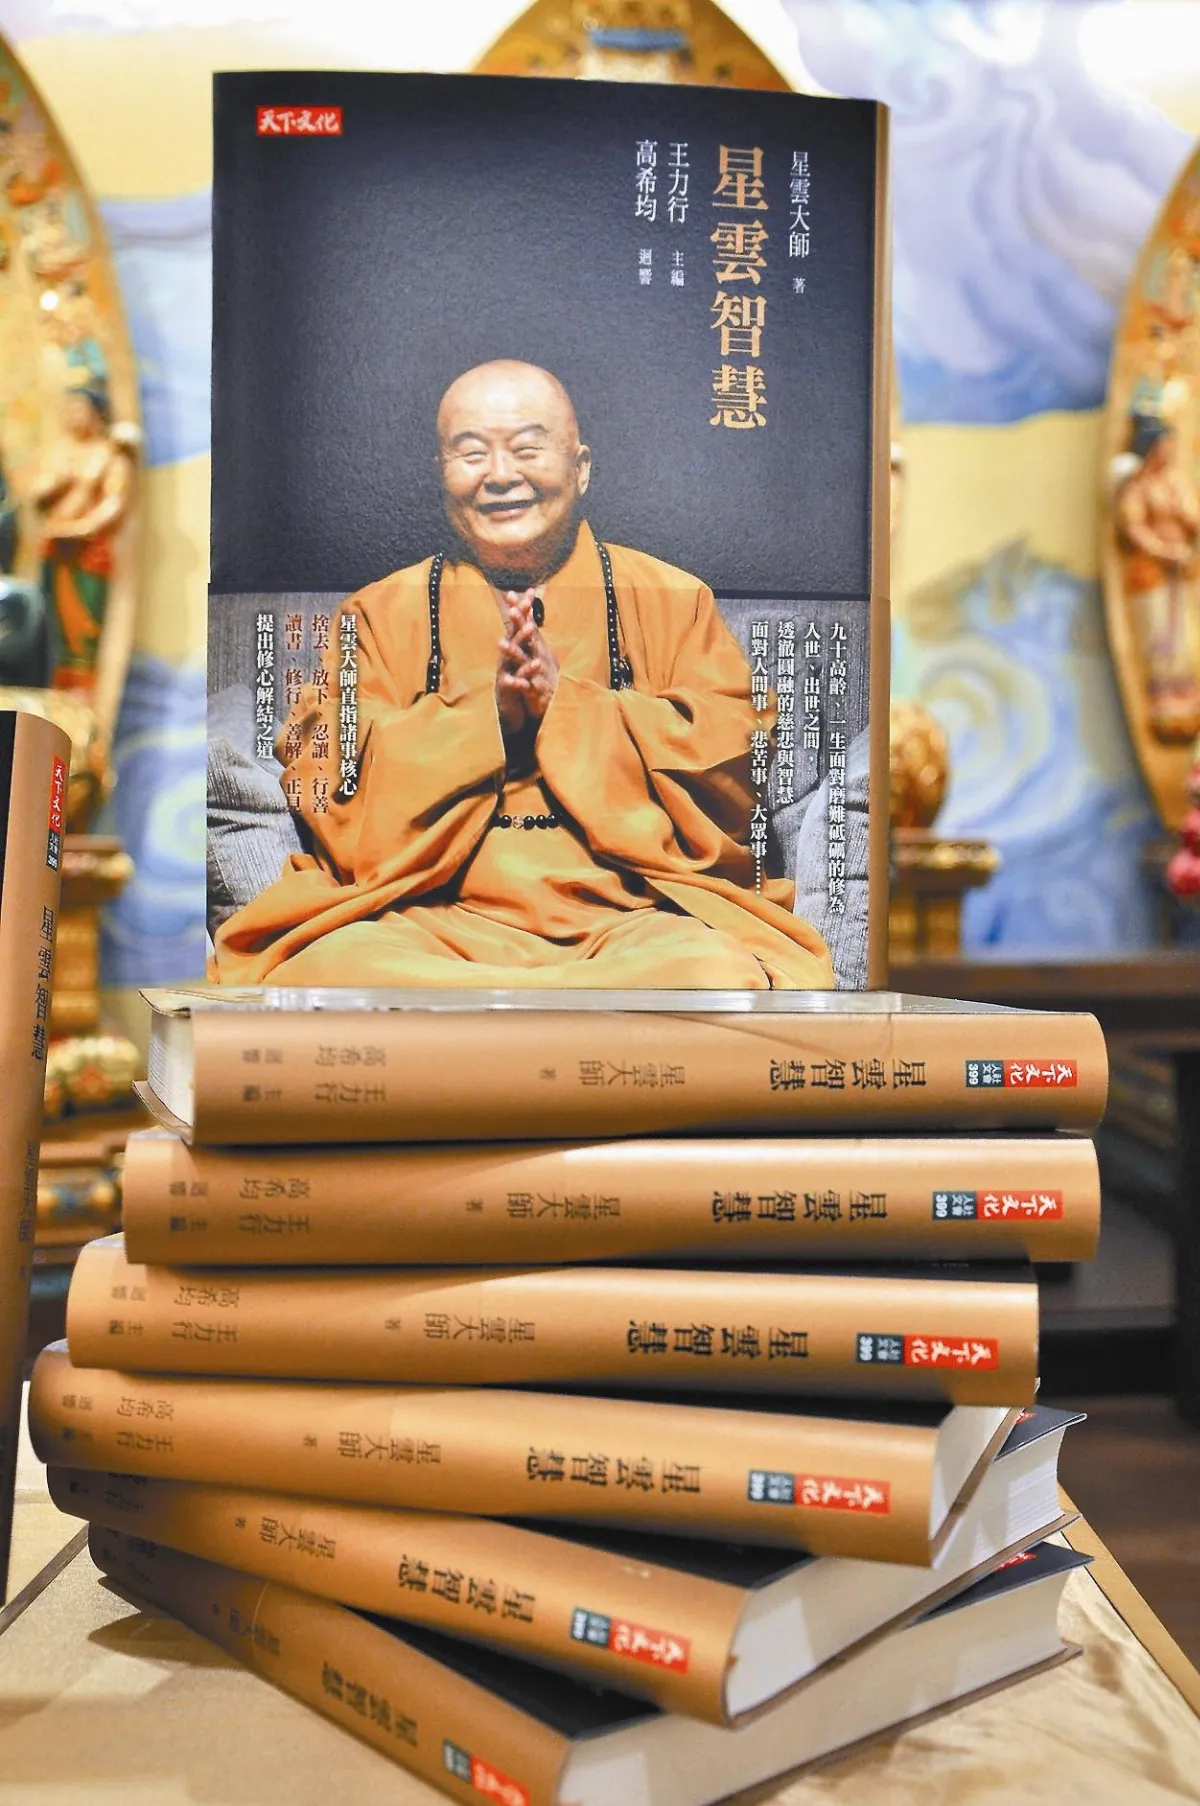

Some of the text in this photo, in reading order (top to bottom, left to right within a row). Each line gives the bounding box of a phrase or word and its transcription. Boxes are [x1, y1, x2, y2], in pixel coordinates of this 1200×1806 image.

[258, 107, 340, 135] 天下文化
[634, 139, 658, 222] 高希均
[667, 142, 690, 287] 王力行 主編
[789, 151, 811, 294] 星雲大師 著
[709, 144, 769, 430] 星雲智慧
[256, 613, 275, 760] 提出修心解結之道
[284, 613, 303, 813] 讀書、修行、善解、正見
[311, 614, 330, 814] 捨去、放下、忍讓、行善
[339, 614, 358, 797] 星雲大師直指諸事核心
[777, 621, 795, 805] 透徹圓融的慈悲與智慧
[51, 763, 63, 828] 天下文化
[32, 904, 54, 1061] 星雲智慧
[314, 1044, 387, 1067] 高希均
[578, 1060, 686, 1090] 星雲大師
[769, 1059, 927, 1091] 星雲智慧
[968, 1062, 979, 1085] 399
[1008, 1062, 1074, 1085] 天下文化
[314, 1082, 387, 1105] 王力行
[238, 1177, 311, 1200] 高希均
[506, 1192, 621, 1220] 星雲大師
[711, 1191, 888, 1223] 星雲智慧
[935, 1194, 947, 1219] 399
[984, 1194, 1057, 1218] 天下文化
[238, 1213, 310, 1234] 王力行
[174, 1284, 240, 1308] 高希均
[172, 1320, 239, 1343] 王力行
[423, 1312, 536, 1344] 星雲大師
[627, 1320, 809, 1360] 星雲智慧
[911, 1338, 992, 1366] 天下文化
[116, 1395, 175, 1422] 高希均
[116, 1429, 175, 1453] 王力行
[337, 1430, 442, 1465] 星雲大師
[525, 1446, 701, 1495] 星雲智慧
[803, 1477, 886, 1511] 天下文化
[259, 1516, 336, 1560] 星雲大師
[399, 1554, 537, 1624] 星雲智慧
